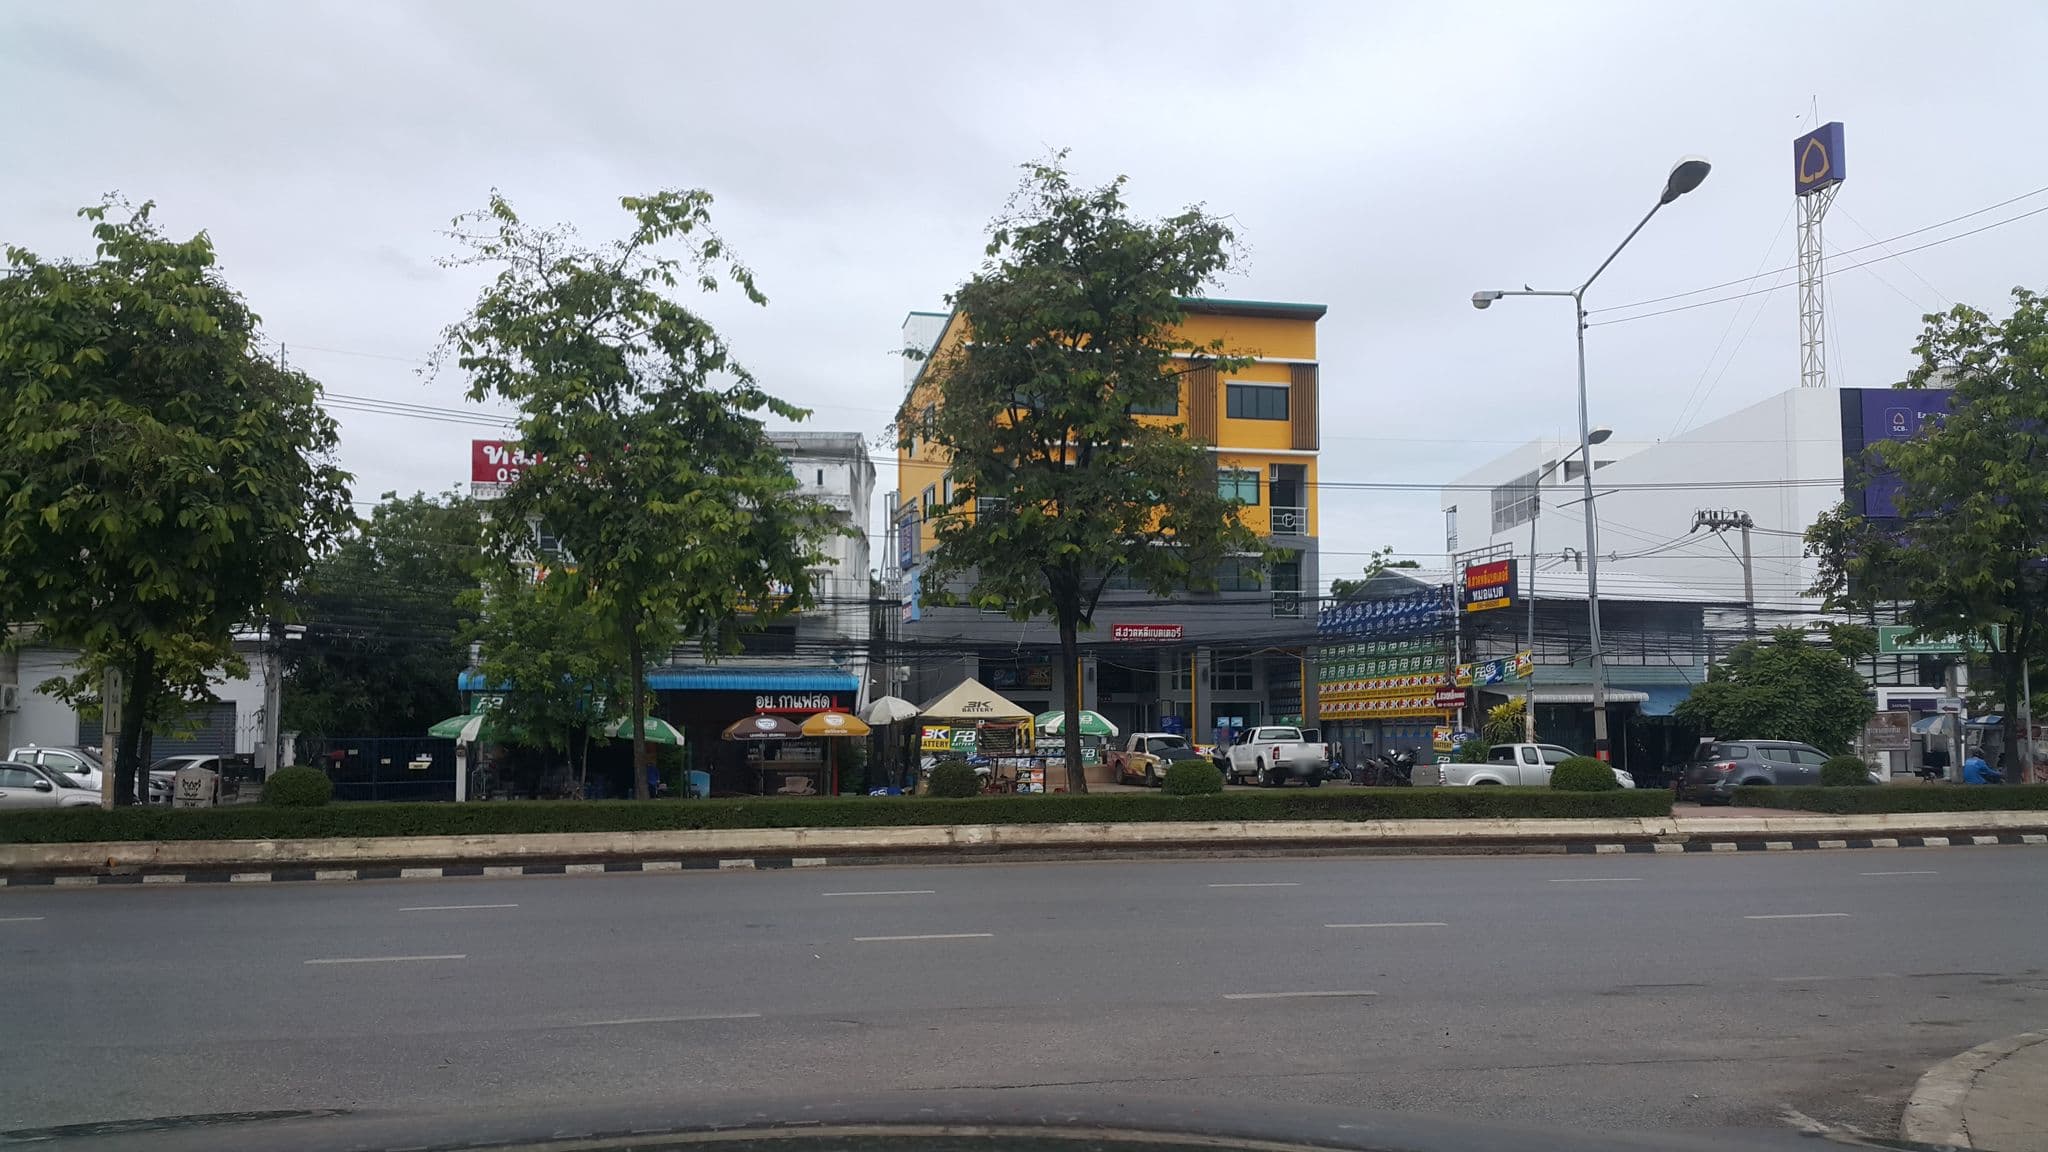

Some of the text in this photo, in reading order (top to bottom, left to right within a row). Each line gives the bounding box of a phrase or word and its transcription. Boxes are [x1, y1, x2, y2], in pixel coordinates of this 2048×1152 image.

[756, 692, 831, 708] อย. กาแฟสด
[922, 729, 949, 739] 3K
[953, 731, 976, 742] FB
